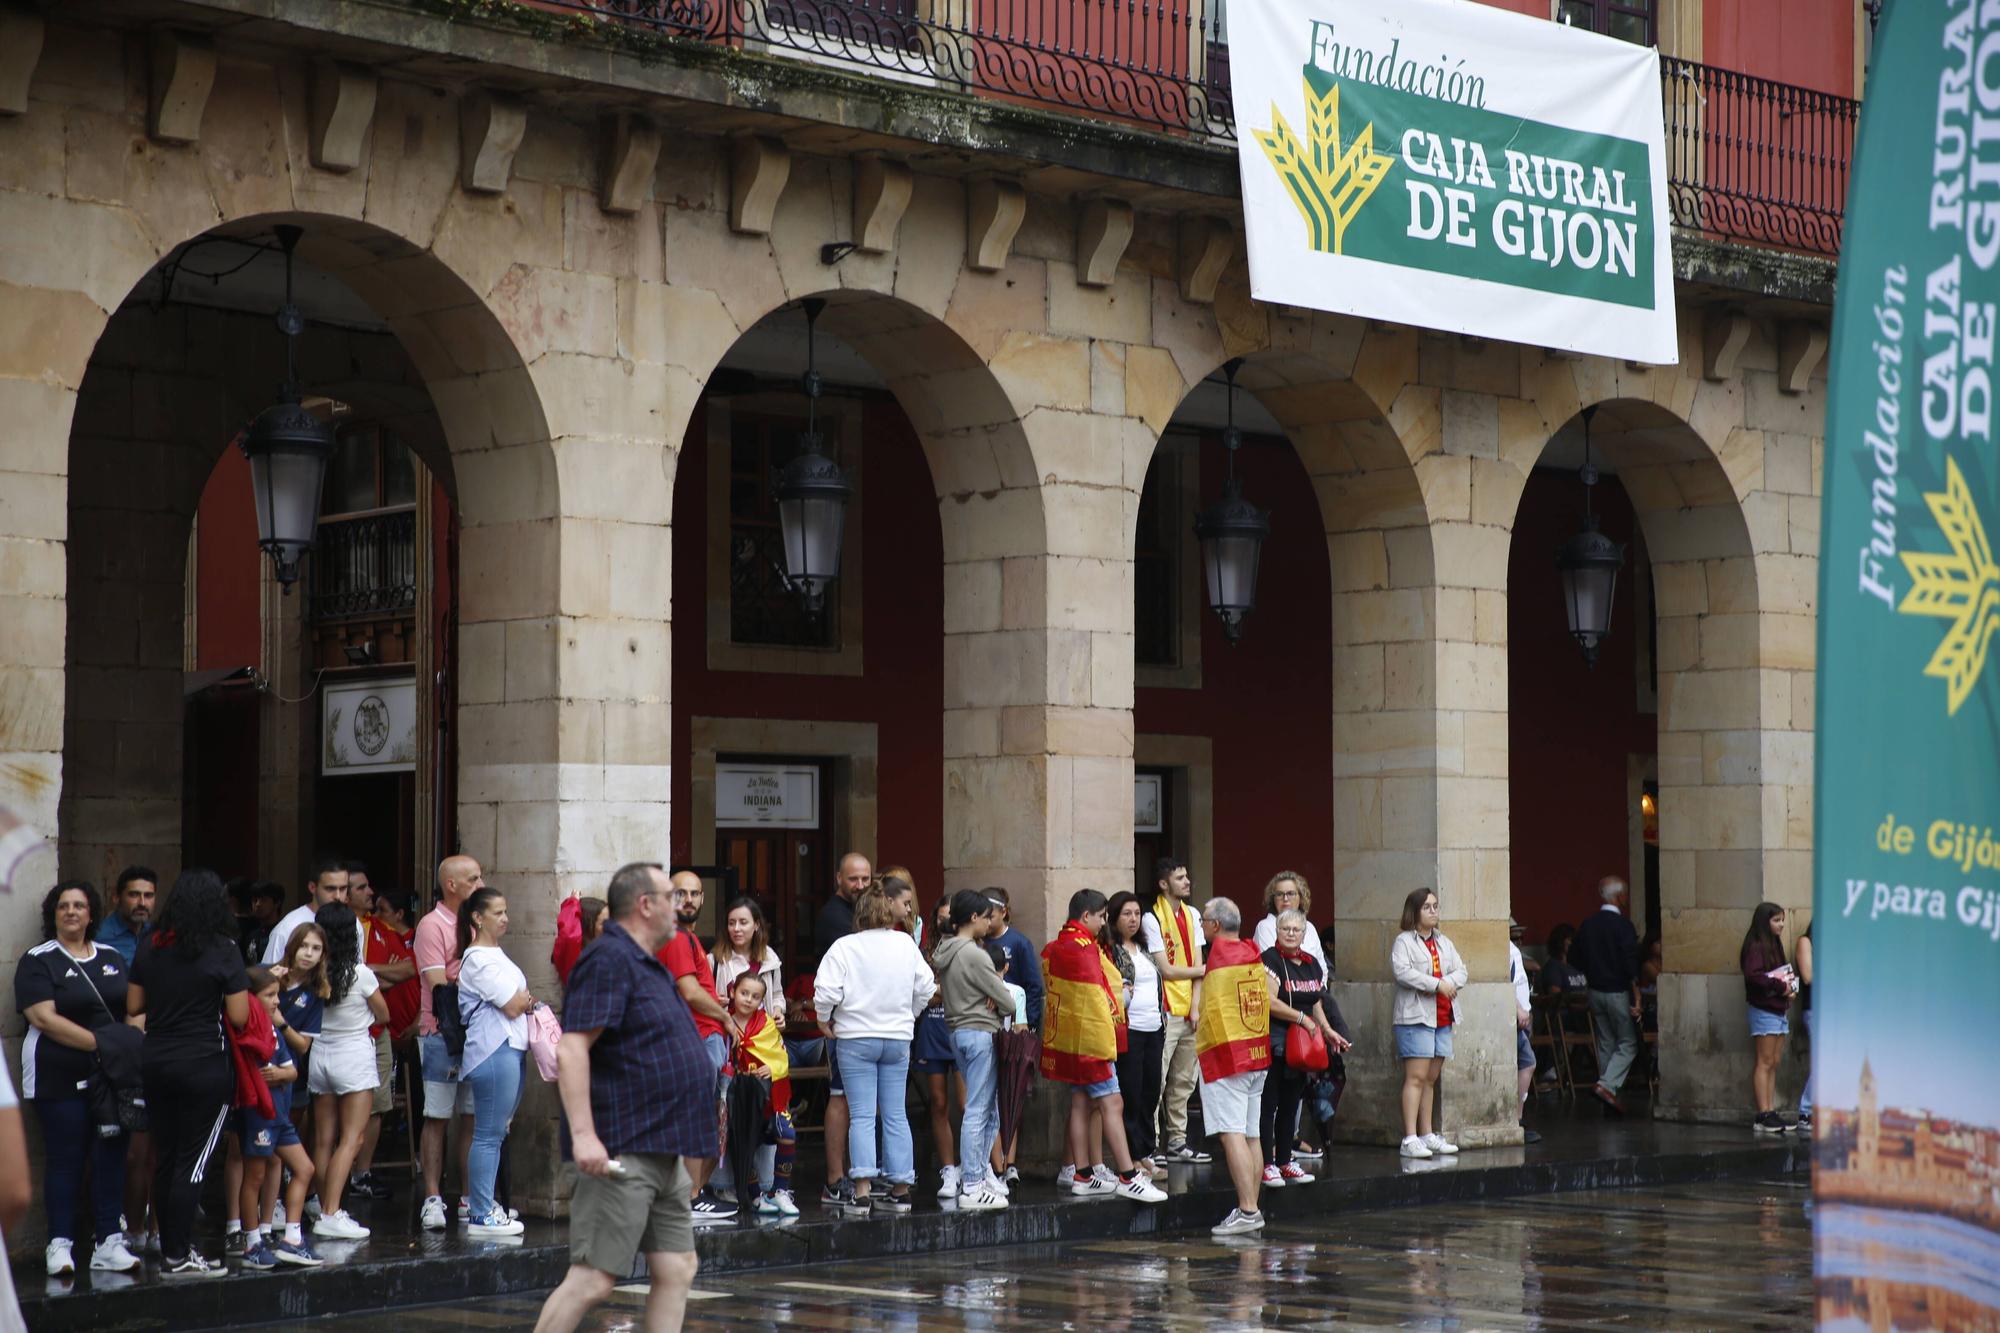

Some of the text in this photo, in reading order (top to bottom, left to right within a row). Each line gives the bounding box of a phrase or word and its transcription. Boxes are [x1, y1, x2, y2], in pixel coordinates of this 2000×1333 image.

[1303, 19, 1487, 109] Fundación
[1401, 128, 1637, 217] CAJA RURAL
[1405, 180, 1637, 279] DE GIJON
[1921, 0, 1975, 440] CAJA RURA
[1960, 301, 1997, 442] DE
[1859, 264, 1908, 611] Fundación
[743, 794, 782, 807] INDIANA
[1876, 813, 1915, 854] de
[1842, 879, 1867, 918] y
[1870, 881, 1947, 921] para
